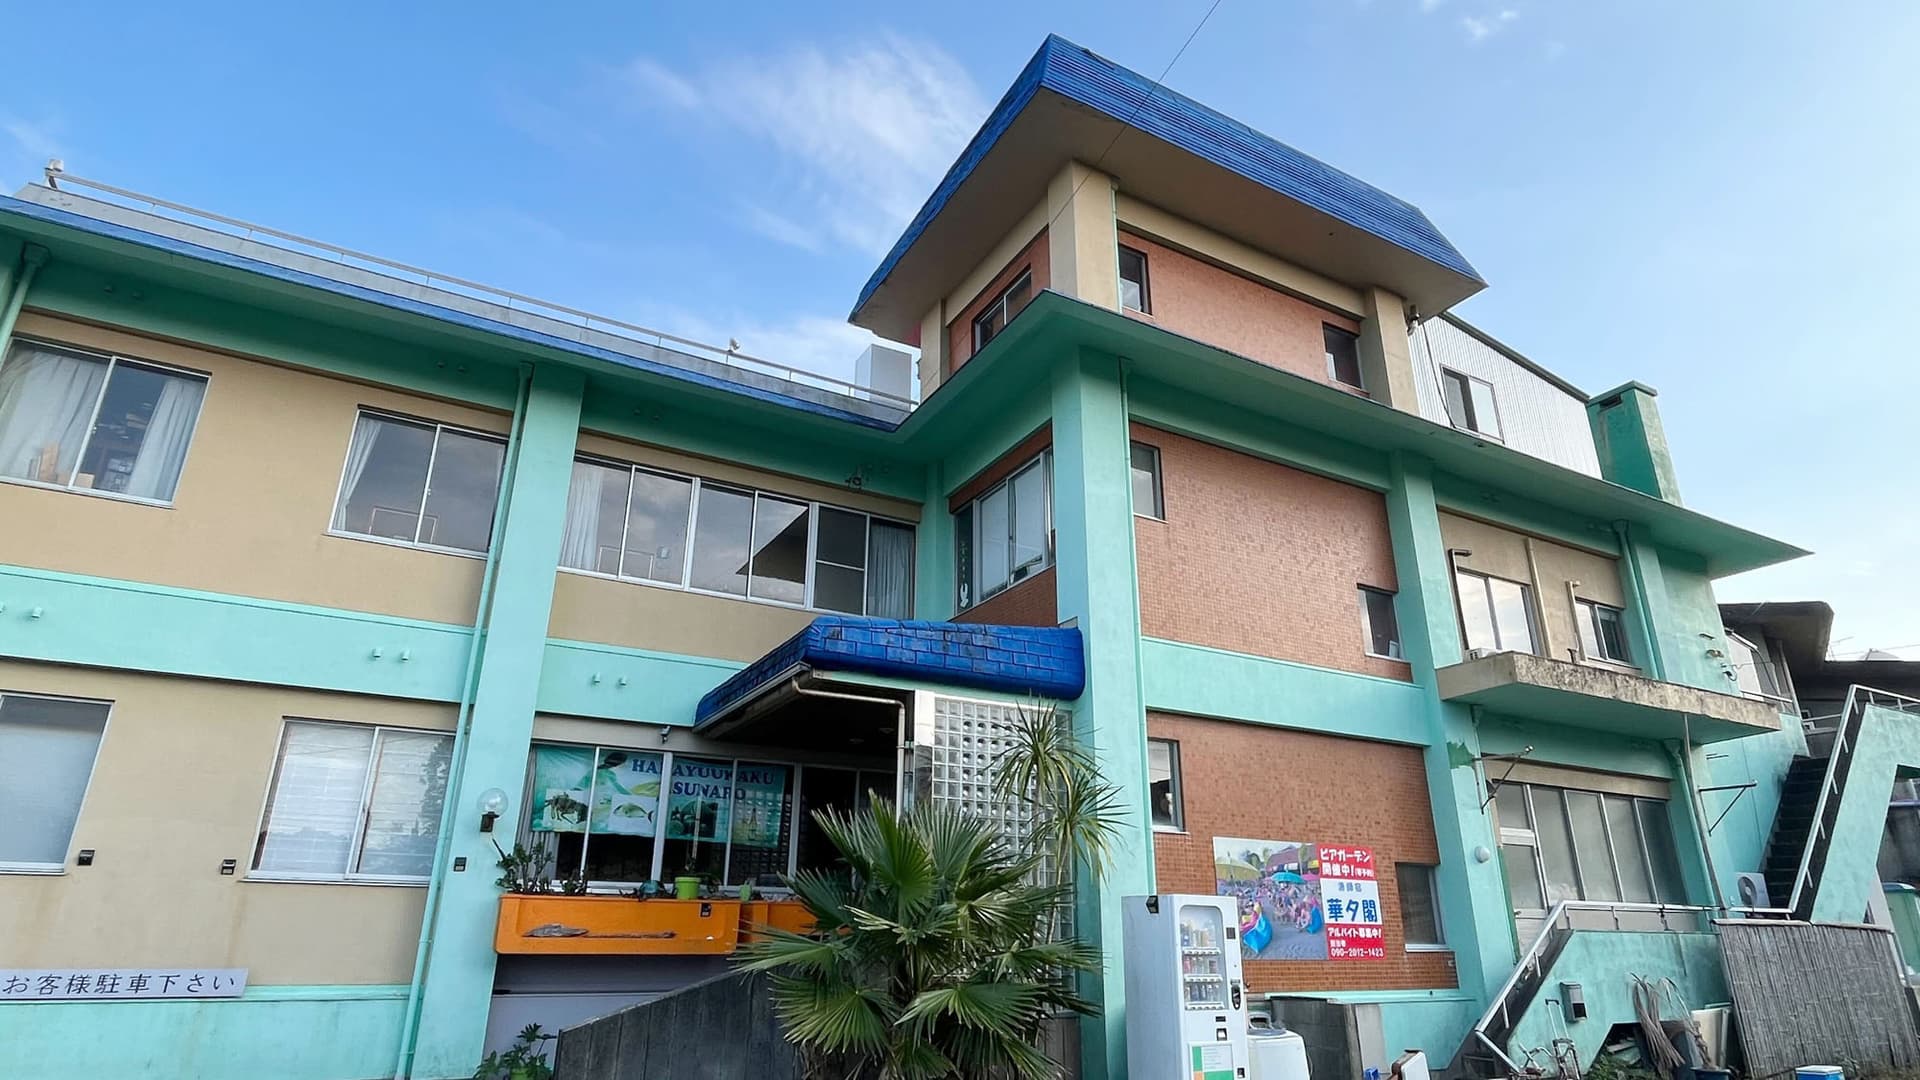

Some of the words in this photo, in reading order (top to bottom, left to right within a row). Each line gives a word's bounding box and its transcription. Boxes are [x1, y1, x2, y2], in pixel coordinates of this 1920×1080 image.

[632, 759, 774, 784] HAAYUUKAKU
[1320, 848, 1370, 863] ビアガーデン
[1327, 898, 1377, 923] 華夕閣
[2, 973, 235, 995] お客様駐車下さい
